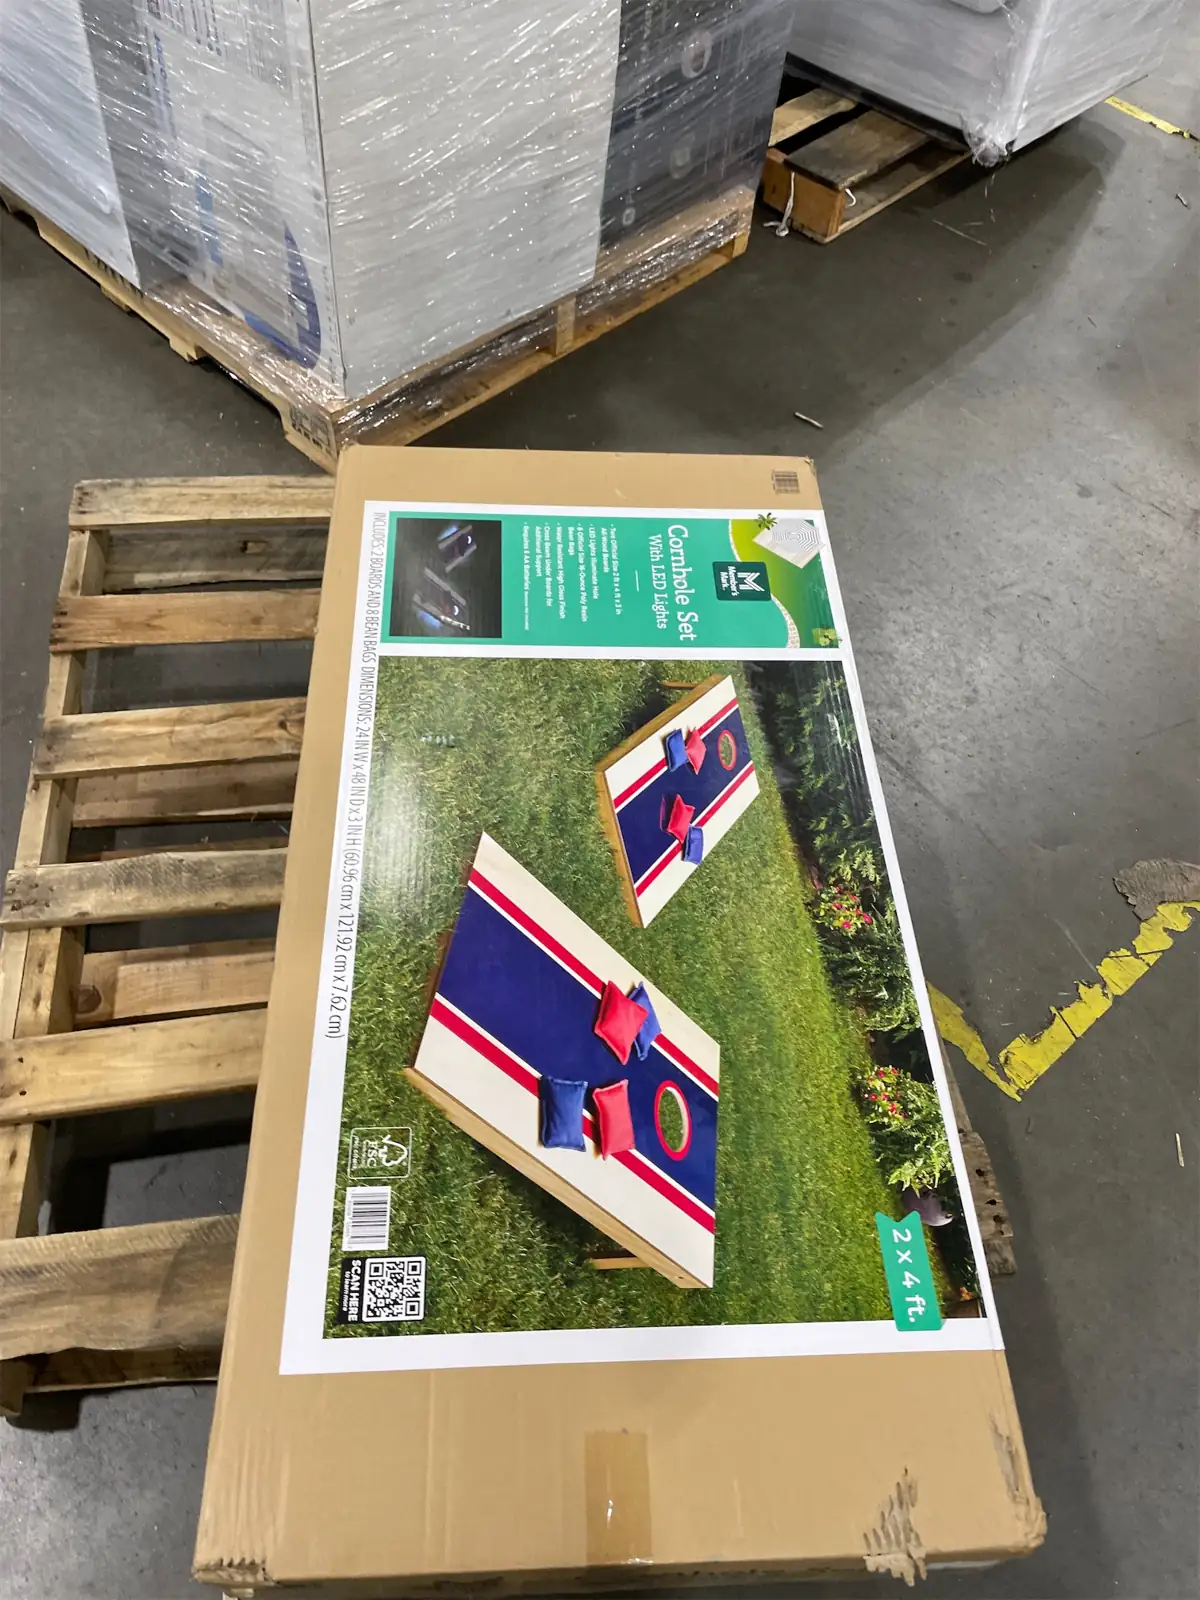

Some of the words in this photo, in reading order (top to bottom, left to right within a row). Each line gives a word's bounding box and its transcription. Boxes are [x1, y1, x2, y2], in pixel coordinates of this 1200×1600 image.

[371, 512, 387, 550] INCLUDES:
[588, 540, 596, 556] Lights
[610, 540, 618, 560] Official
[649, 534, 664, 561] With
[524, 555, 530, 564] AA
[534, 554, 542, 577] Support
[668, 524, 695, 605] Cornhole
[368, 558, 384, 589] BOARDS
[556, 570, 564, 584] High
[652, 564, 667, 590] LED
[728, 566, 740, 596] Member's
[366, 590, 382, 608] AND
[546, 598, 554, 607] for
[579, 592, 588, 606] Poly
[558, 601, 566, 618] Finish
[580, 606, 588, 622] Resin
[652, 593, 670, 629] Lights
[364, 616, 379, 639] BEAN
[676, 611, 698, 641] Set
[361, 640, 378, 663] BAGS
[356, 666, 376, 725] DIMENSIONS:
[356, 726, 370, 738] 24
[354, 740, 370, 750] IN
[354, 751, 369, 762] W
[351, 772, 366, 784] 48
[350, 786, 366, 796] IN
[349, 798, 365, 806] D
[346, 824, 362, 836] IN
[342, 848, 361, 882] (60.96
[340, 884, 354, 901] cm
[336, 914, 354, 952] 121.92
[334, 955, 348, 972] cm
[330, 985, 348, 1012] 7.62
[324, 1015, 346, 1038] cm)
[892, 1228, 912, 1243] 2
[896, 1250, 912, 1264] x
[350, 1260, 362, 1290] SCAN
[902, 1271, 920, 1288] 4
[348, 1292, 360, 1322] HERE
[905, 1294, 926, 1322] ft.
